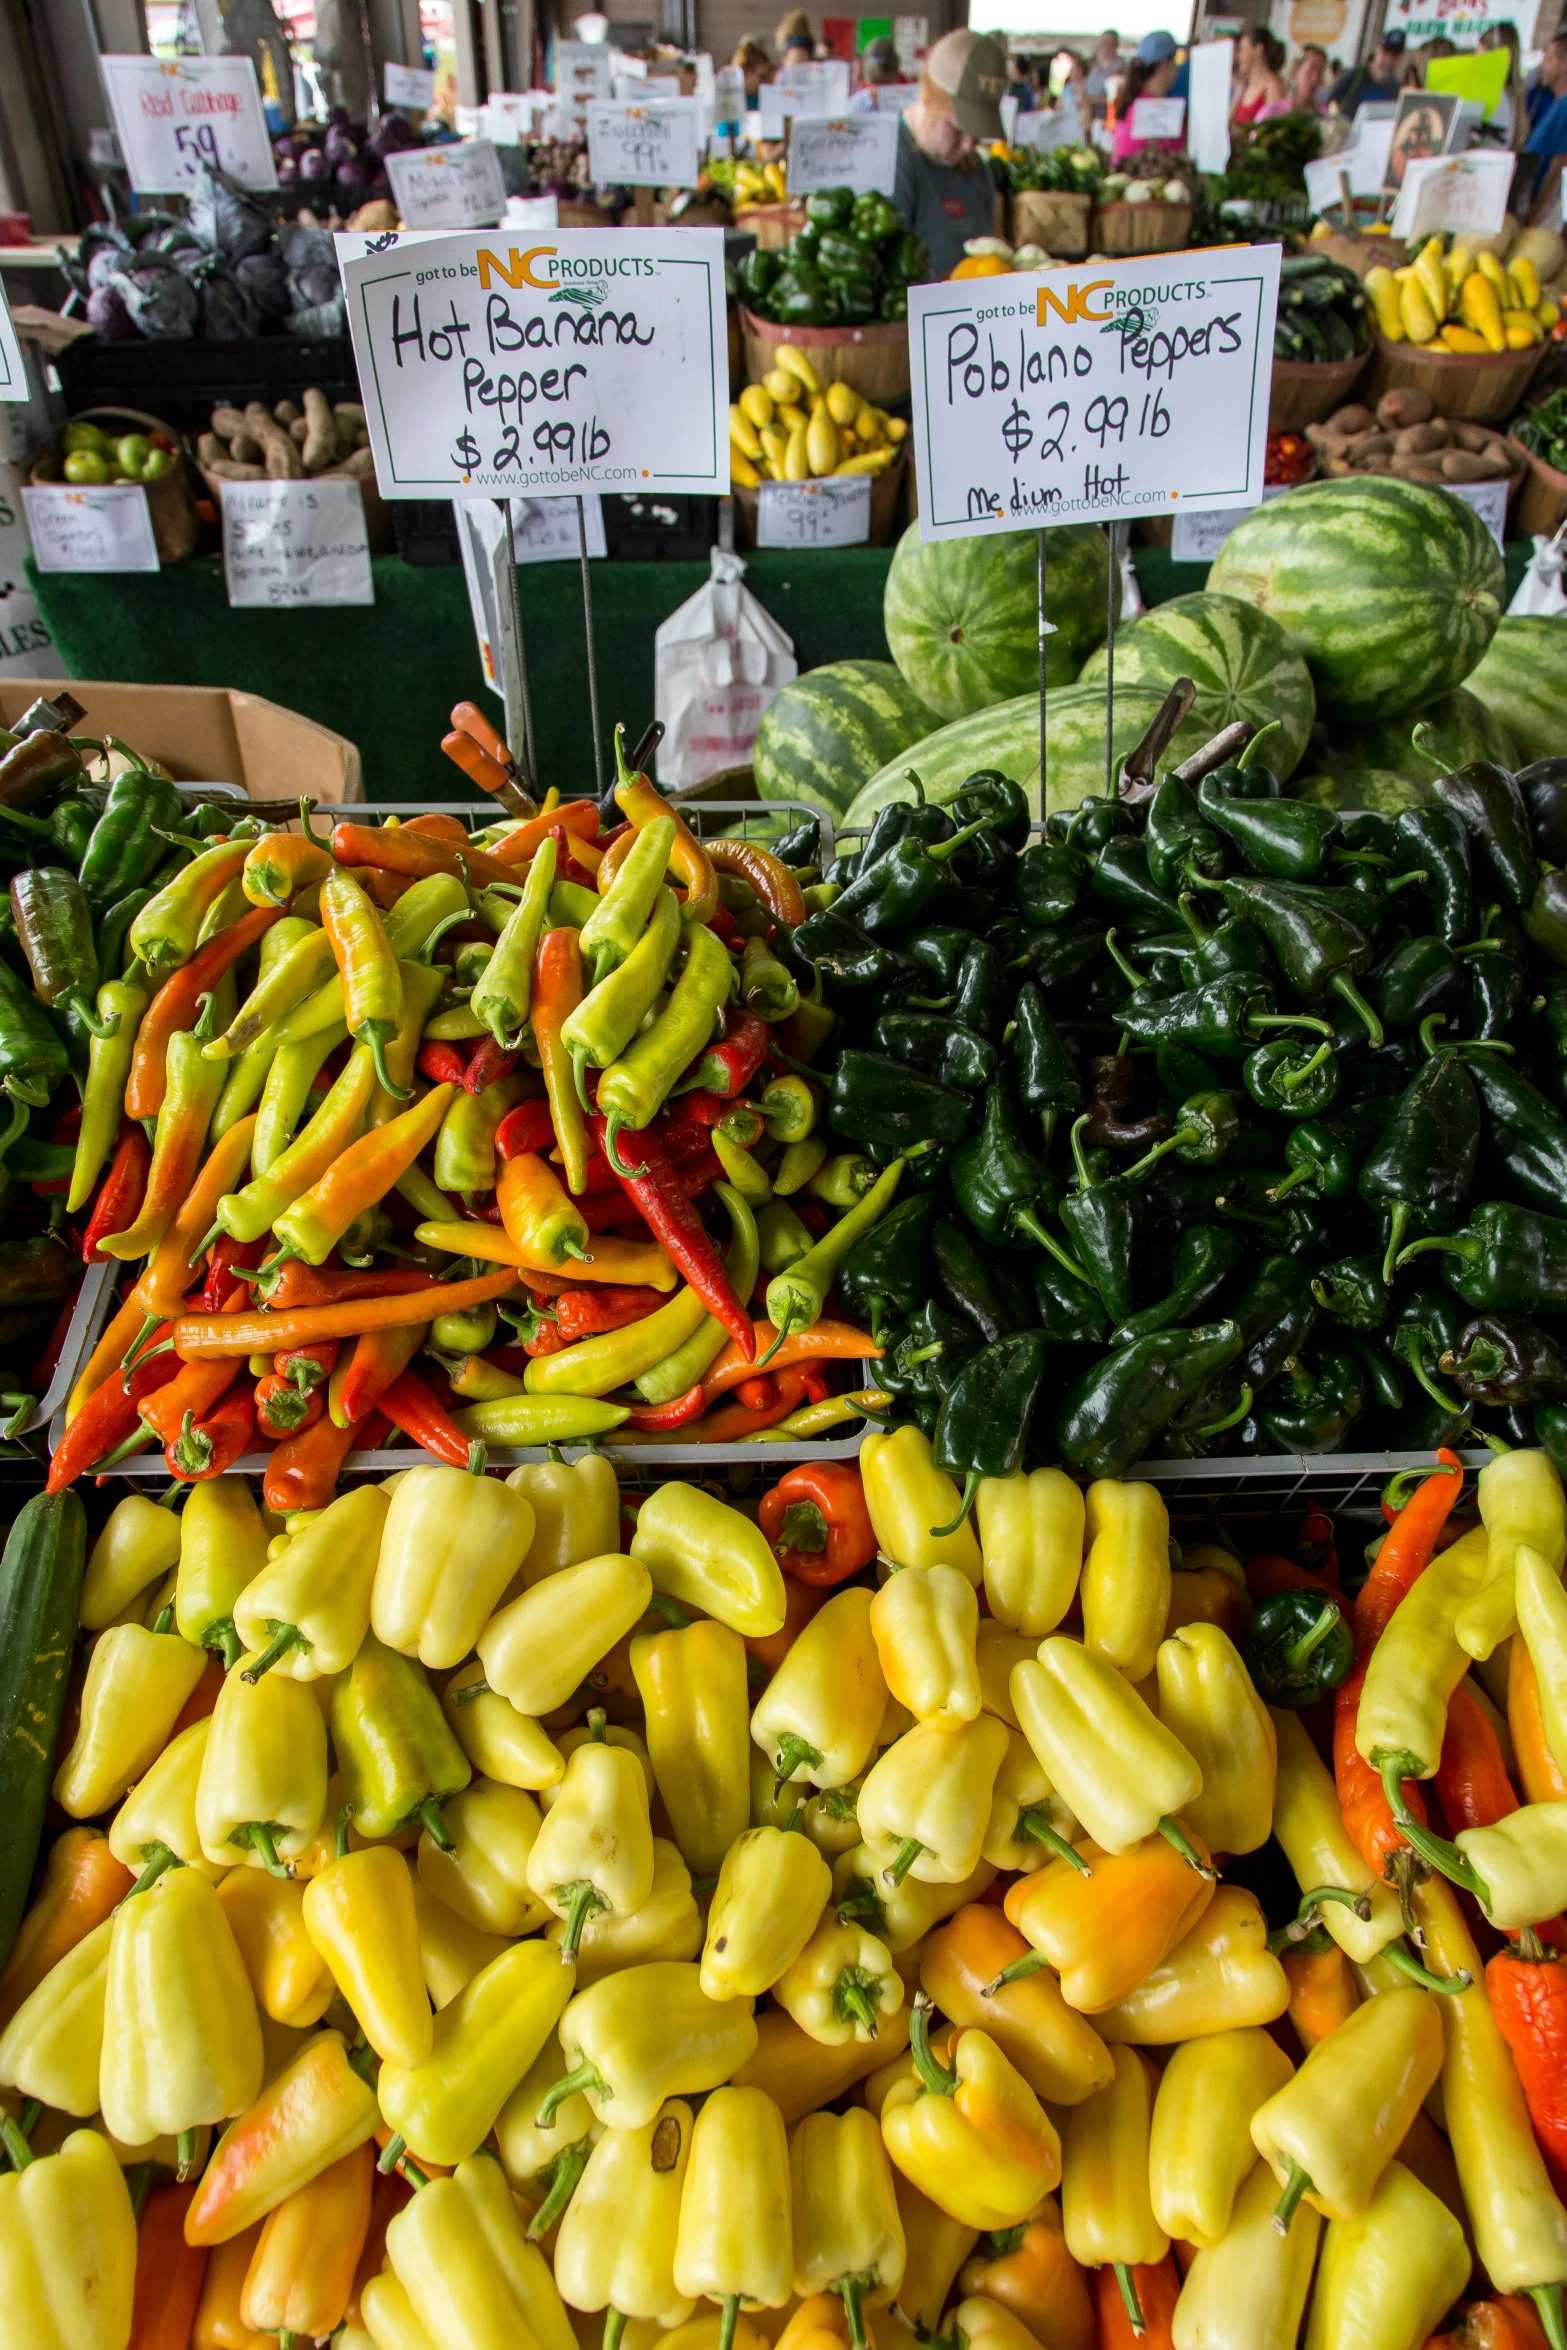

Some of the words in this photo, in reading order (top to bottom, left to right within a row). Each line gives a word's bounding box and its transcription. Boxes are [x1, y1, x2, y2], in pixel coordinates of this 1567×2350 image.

[416, 268, 440, 285] got
[442, 267, 457, 279] to
[460, 263, 477, 276] be
[476, 247, 560, 290] NC
[548, 258, 654, 278] PRODUCTS
[976, 306, 998, 323] got
[1002, 306, 1015, 317] to
[1019, 302, 1036, 315] be
[1037, 280, 1115, 327] NC
[1104, 281, 1206, 310] PRODUCTS
[391, 293, 470, 367] Hot
[486, 293, 655, 356] Banana
[947, 322, 1093, 405] Poblano
[1120, 307, 1242, 380] Peppers
[463, 357, 587, 424] Pepper
[476, 465, 637, 488] www.gottobeNC.com
[967, 477, 1063, 520] Medium
[1084, 463, 1130, 500] Hot
[1010, 490, 1166, 517] www.gottobeNC.com
